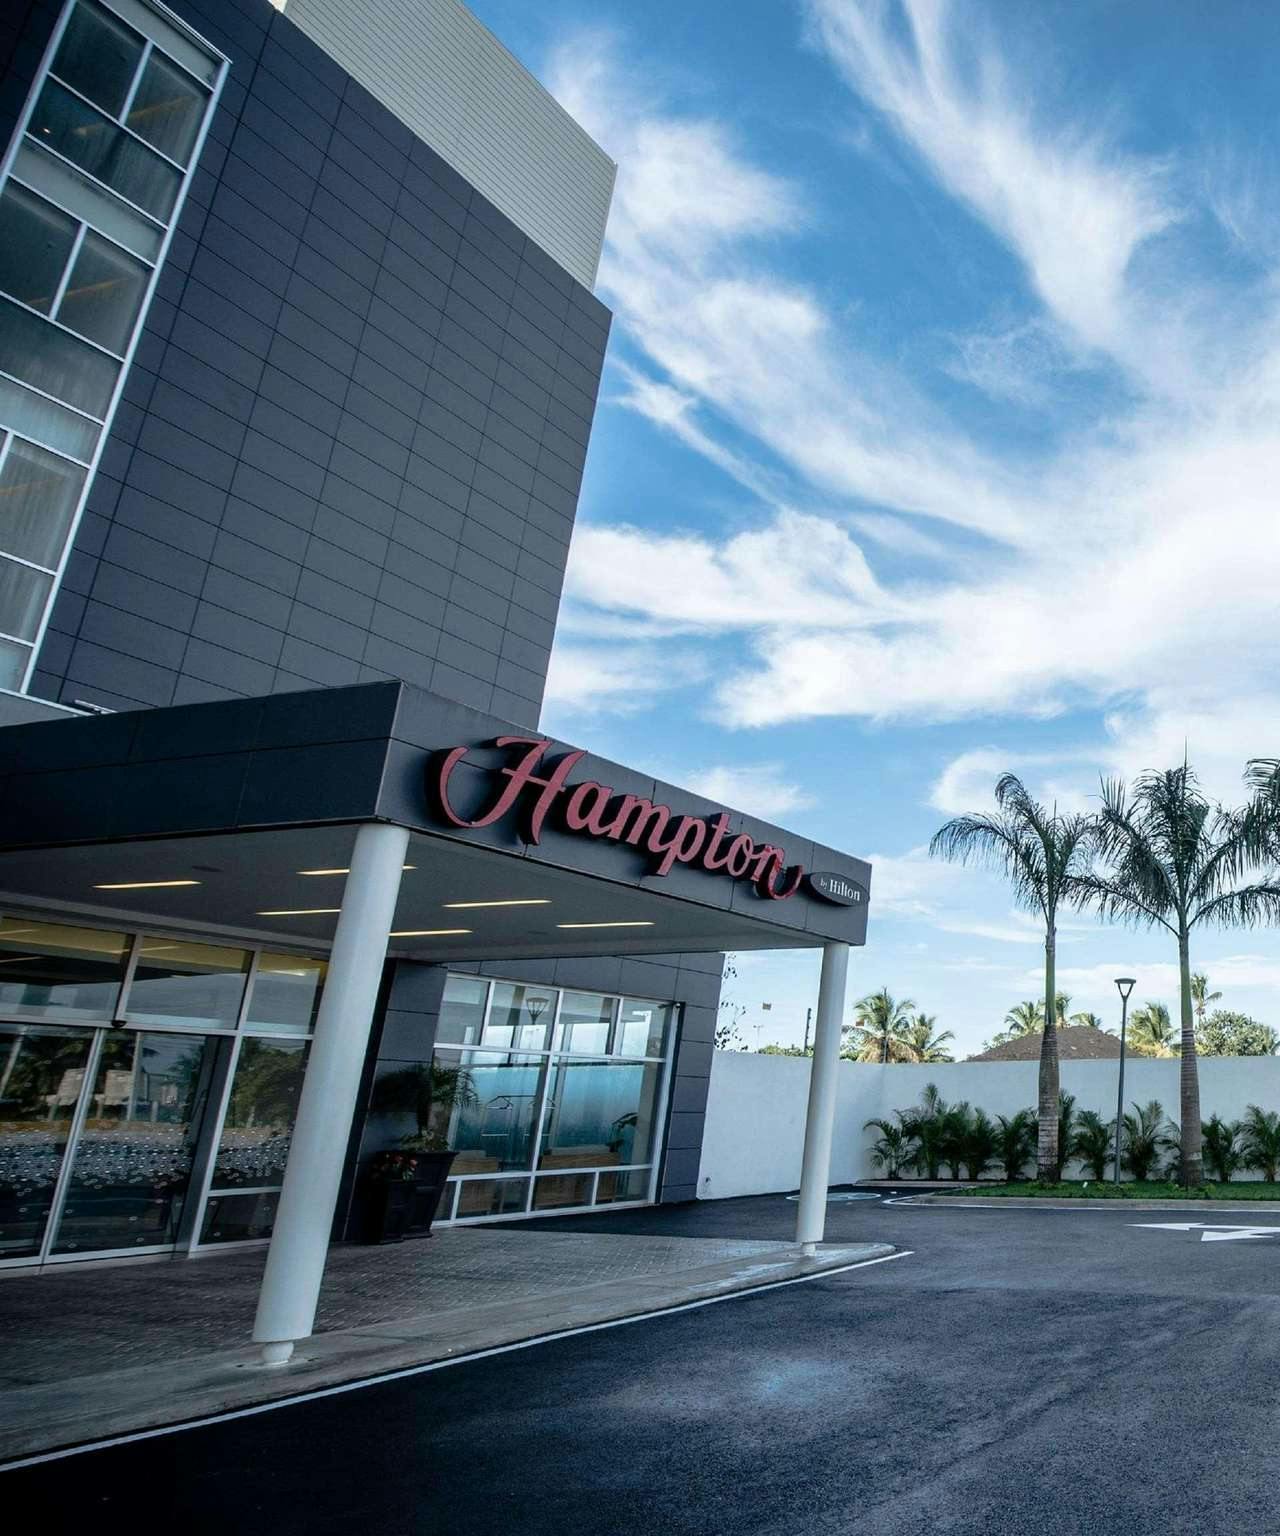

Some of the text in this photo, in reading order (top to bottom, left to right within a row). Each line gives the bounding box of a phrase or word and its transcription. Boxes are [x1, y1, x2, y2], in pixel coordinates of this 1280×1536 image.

[438, 735, 804, 900] Hampton
[820, 877, 861, 902] by Hilton
